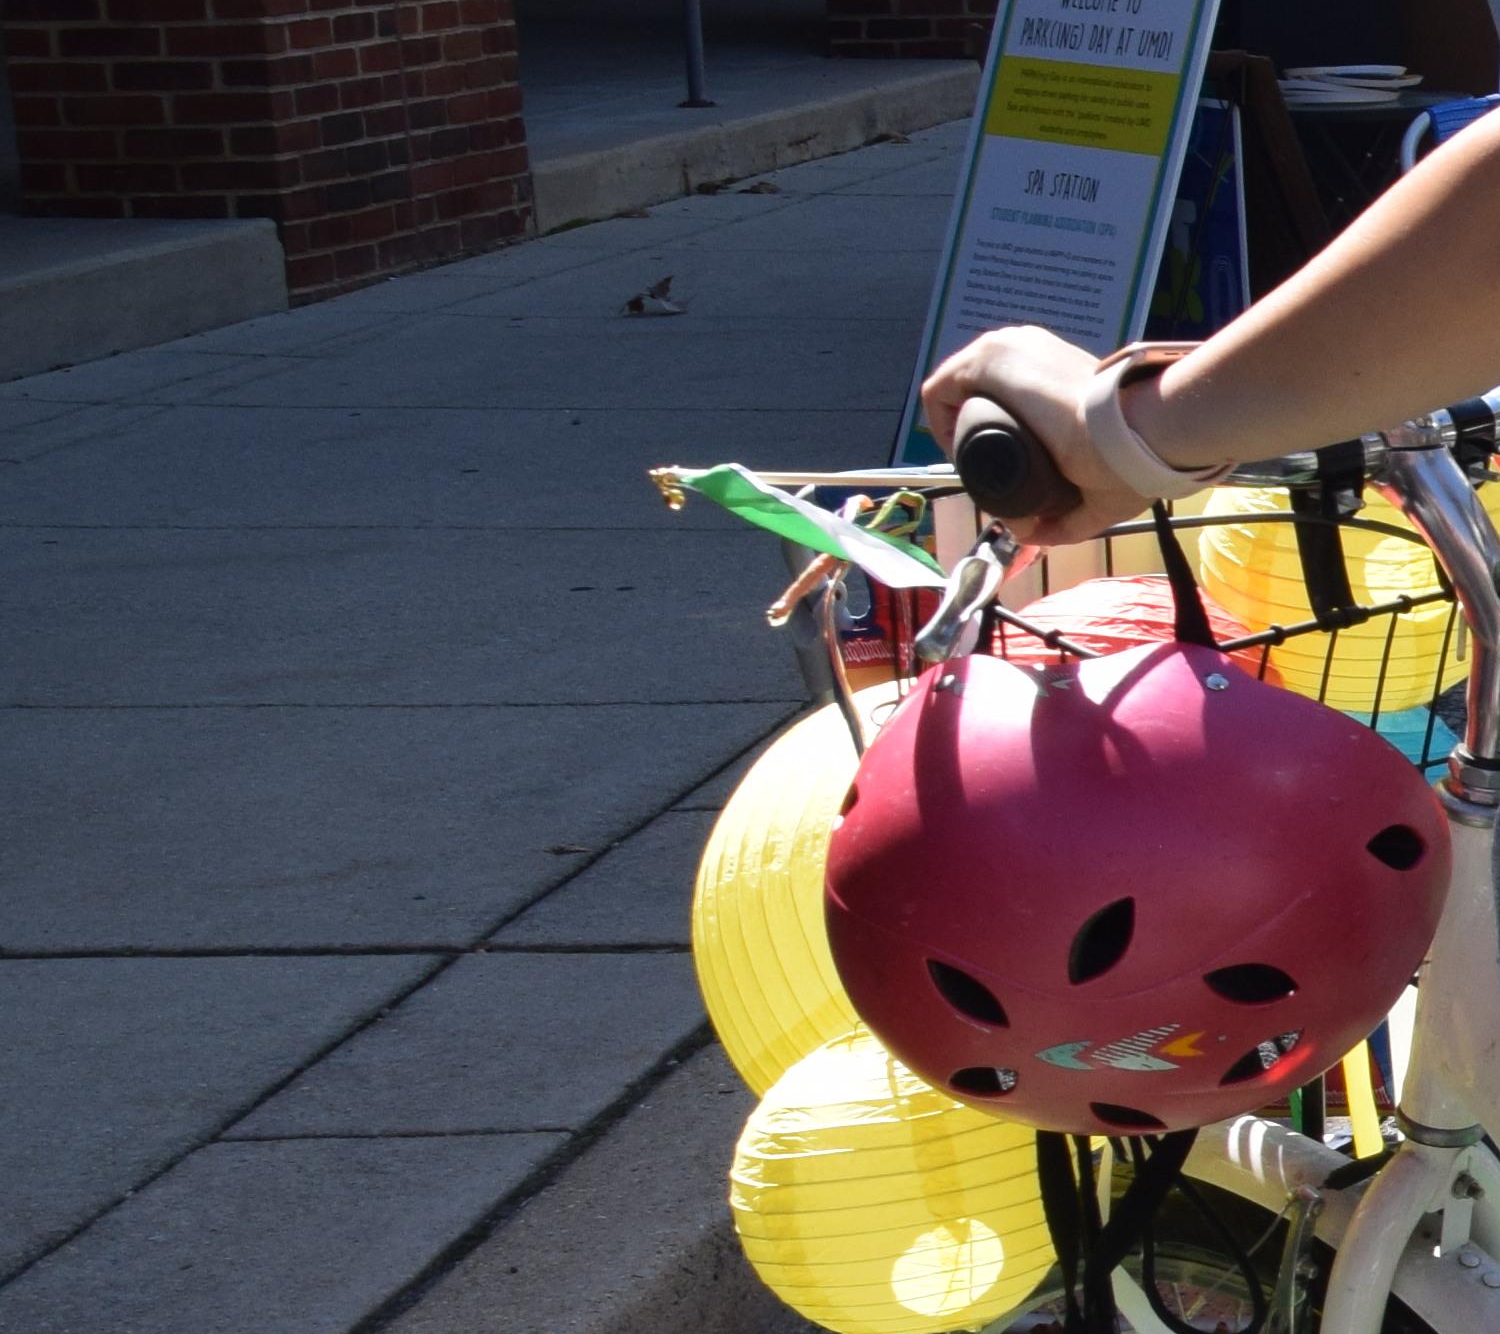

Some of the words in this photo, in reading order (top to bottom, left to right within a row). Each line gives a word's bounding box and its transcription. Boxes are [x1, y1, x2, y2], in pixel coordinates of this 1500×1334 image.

[1019, 17, 1086, 51] PARK(ING)
[1088, 25, 1114, 55] DAY
[1115, 27, 1135, 56] AT
[1138, 29, 1175, 62] UMD!
[1024, 169, 1045, 196] SPA
[1049, 173, 1100, 203] STATION
